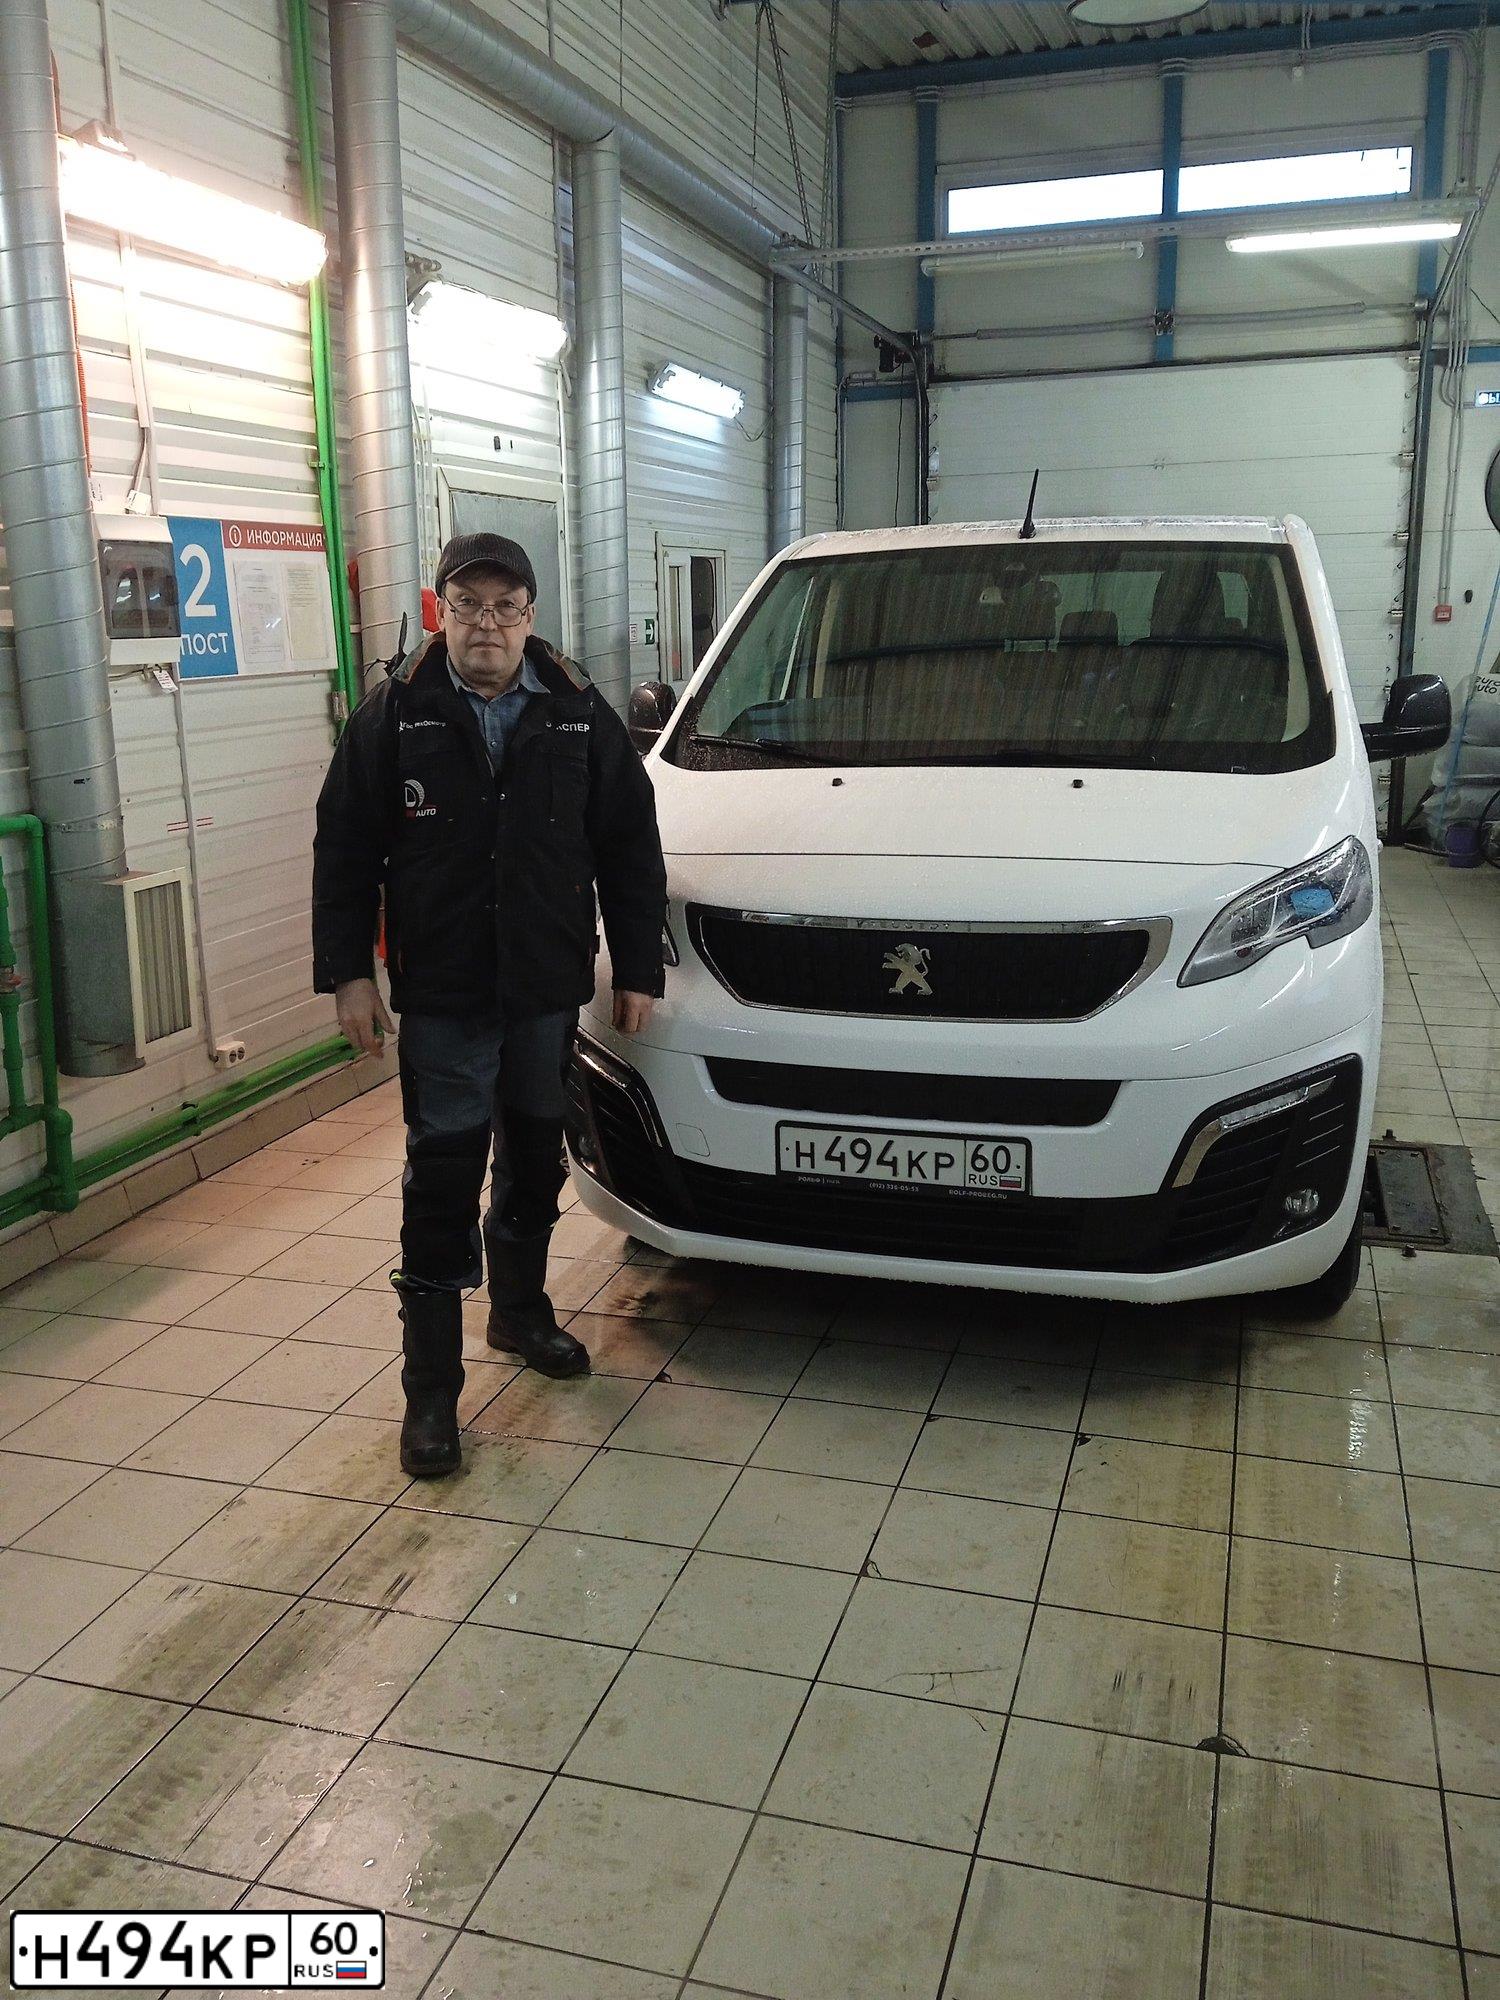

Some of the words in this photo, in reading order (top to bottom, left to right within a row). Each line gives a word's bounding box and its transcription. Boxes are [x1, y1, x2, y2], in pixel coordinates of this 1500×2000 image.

[246, 529, 323, 547] ИНФОРМАЦИЯ
[179, 543, 217, 617] 2
[181, 632, 228, 656] ПОСТ
[415, 808, 436, 817] AUTO
[970, 1143, 1011, 1174] 60
[968, 1173, 998, 1186] RUS
